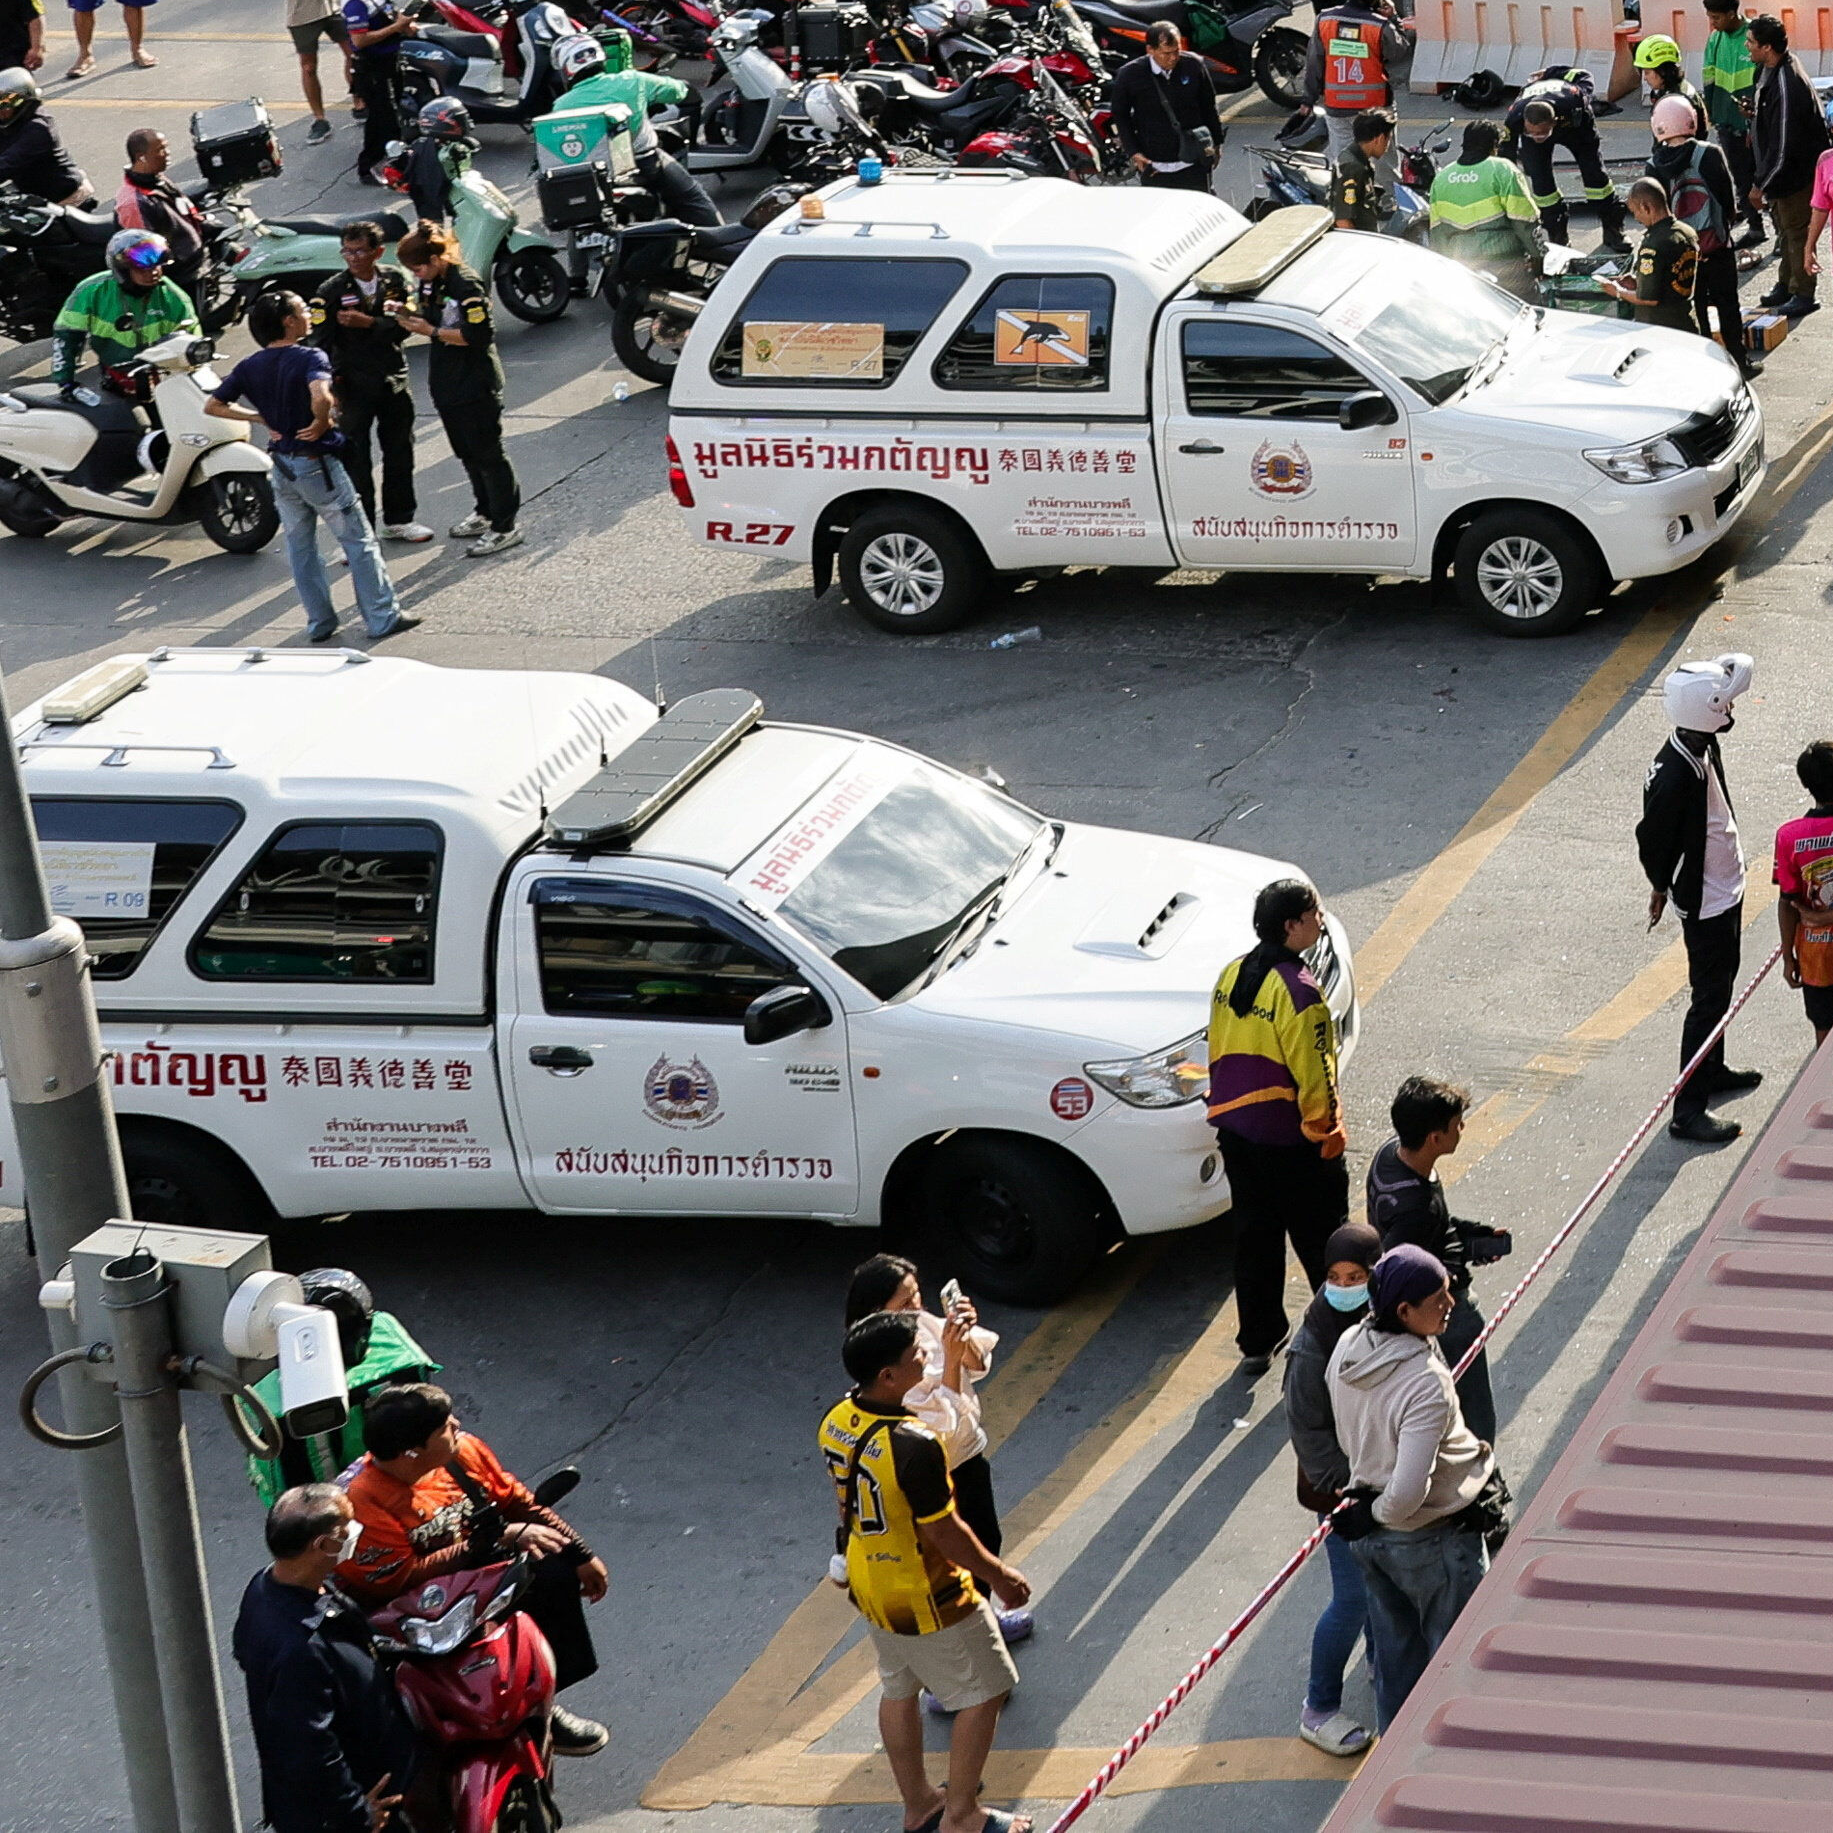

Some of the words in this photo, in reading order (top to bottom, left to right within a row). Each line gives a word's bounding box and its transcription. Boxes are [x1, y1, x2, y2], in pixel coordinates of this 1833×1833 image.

[1333, 57, 1365, 83] 14
[1447, 170, 1479, 184] Grab
[694, 437, 990, 484] มูลนิธิร่วมกตัญญู
[997, 449, 1136, 474] 泰國義德善堂
[706, 520, 797, 546] R.27
[1191, 514, 1398, 544] สนับสนุนกิจการตำรวจ
[281, 1054, 475, 1092] 泰國義德善堂
[325, 1117, 469, 1134] สำนักงานบางพลี
[310, 1155, 492, 1169] TEL.02-7510951-53
[554, 1143, 834, 1181] สนับสนุนกิจการตำรวจ
